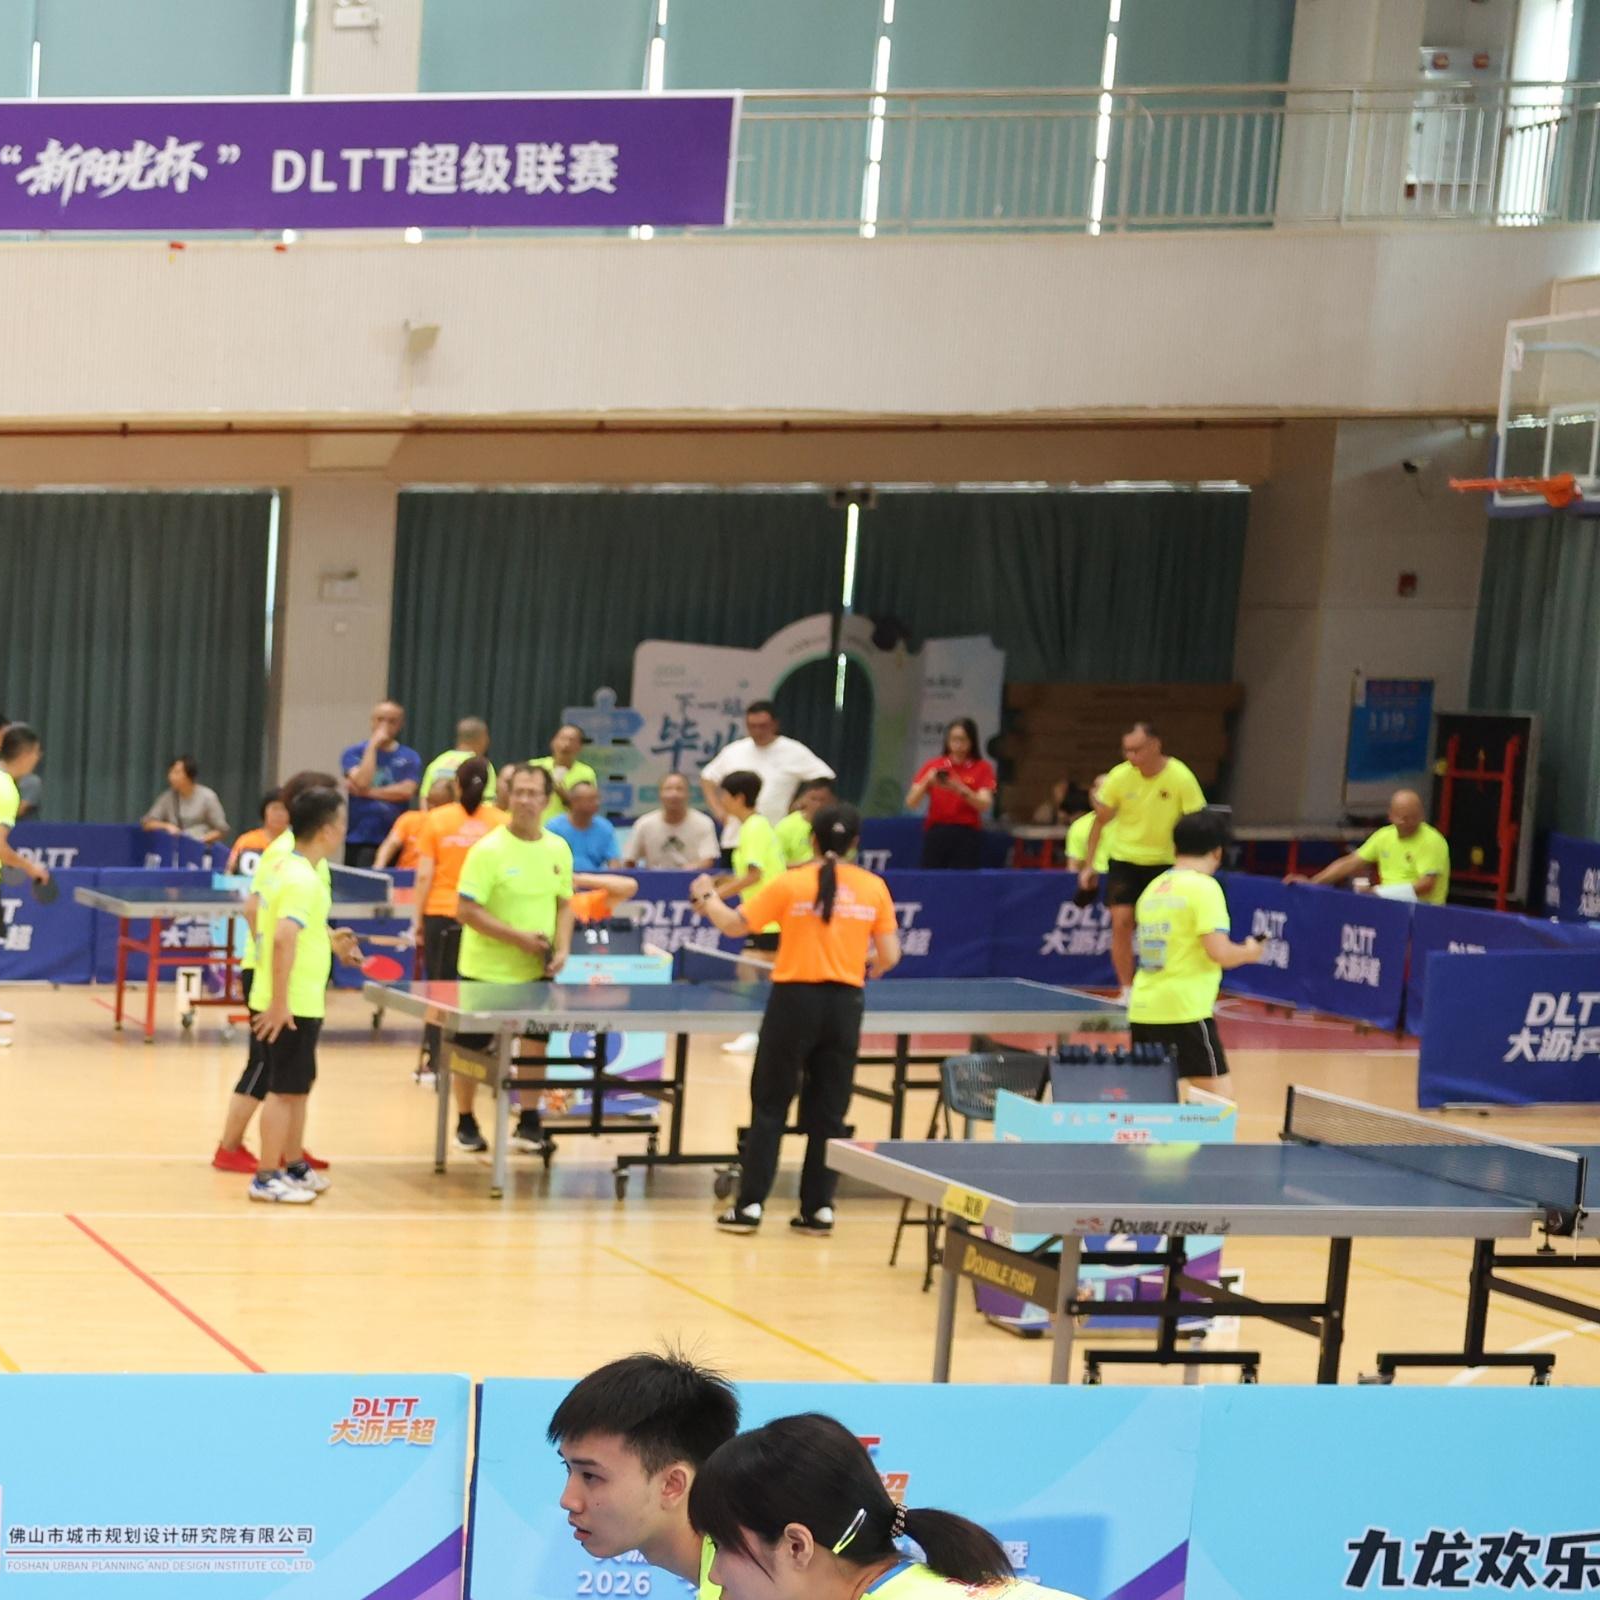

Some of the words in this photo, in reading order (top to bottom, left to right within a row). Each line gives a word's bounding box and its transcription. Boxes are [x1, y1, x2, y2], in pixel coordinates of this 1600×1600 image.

[271, 141, 619, 195] DLTT超级联赛
[1525, 991, 1600, 1027] DLT
[1503, 1027, 1600, 1063] 大沥乒
[1110, 1217, 1171, 1235] DOUBLE
[352, 1397, 419, 1418] DLTT
[330, 1418, 437, 1446] 大沥乒超
[8, 1527, 314, 1545] 佛山市城市规划设计研究院有限公司
[8, 1561, 48, 1571] FOSHAN
[53, 1561, 89, 1571] URBAN
[92, 1561, 145, 1571] PLANNING
[148, 1561, 169, 1571] AND
[173, 1561, 212, 1571] DESIGN
[214, 1561, 267, 1571] INSTITUTE
[294, 1561, 313, 1571] LTD
[1345, 1529, 1600, 1592] 九龙欢乐
[578, 1570, 652, 1595] 2026
